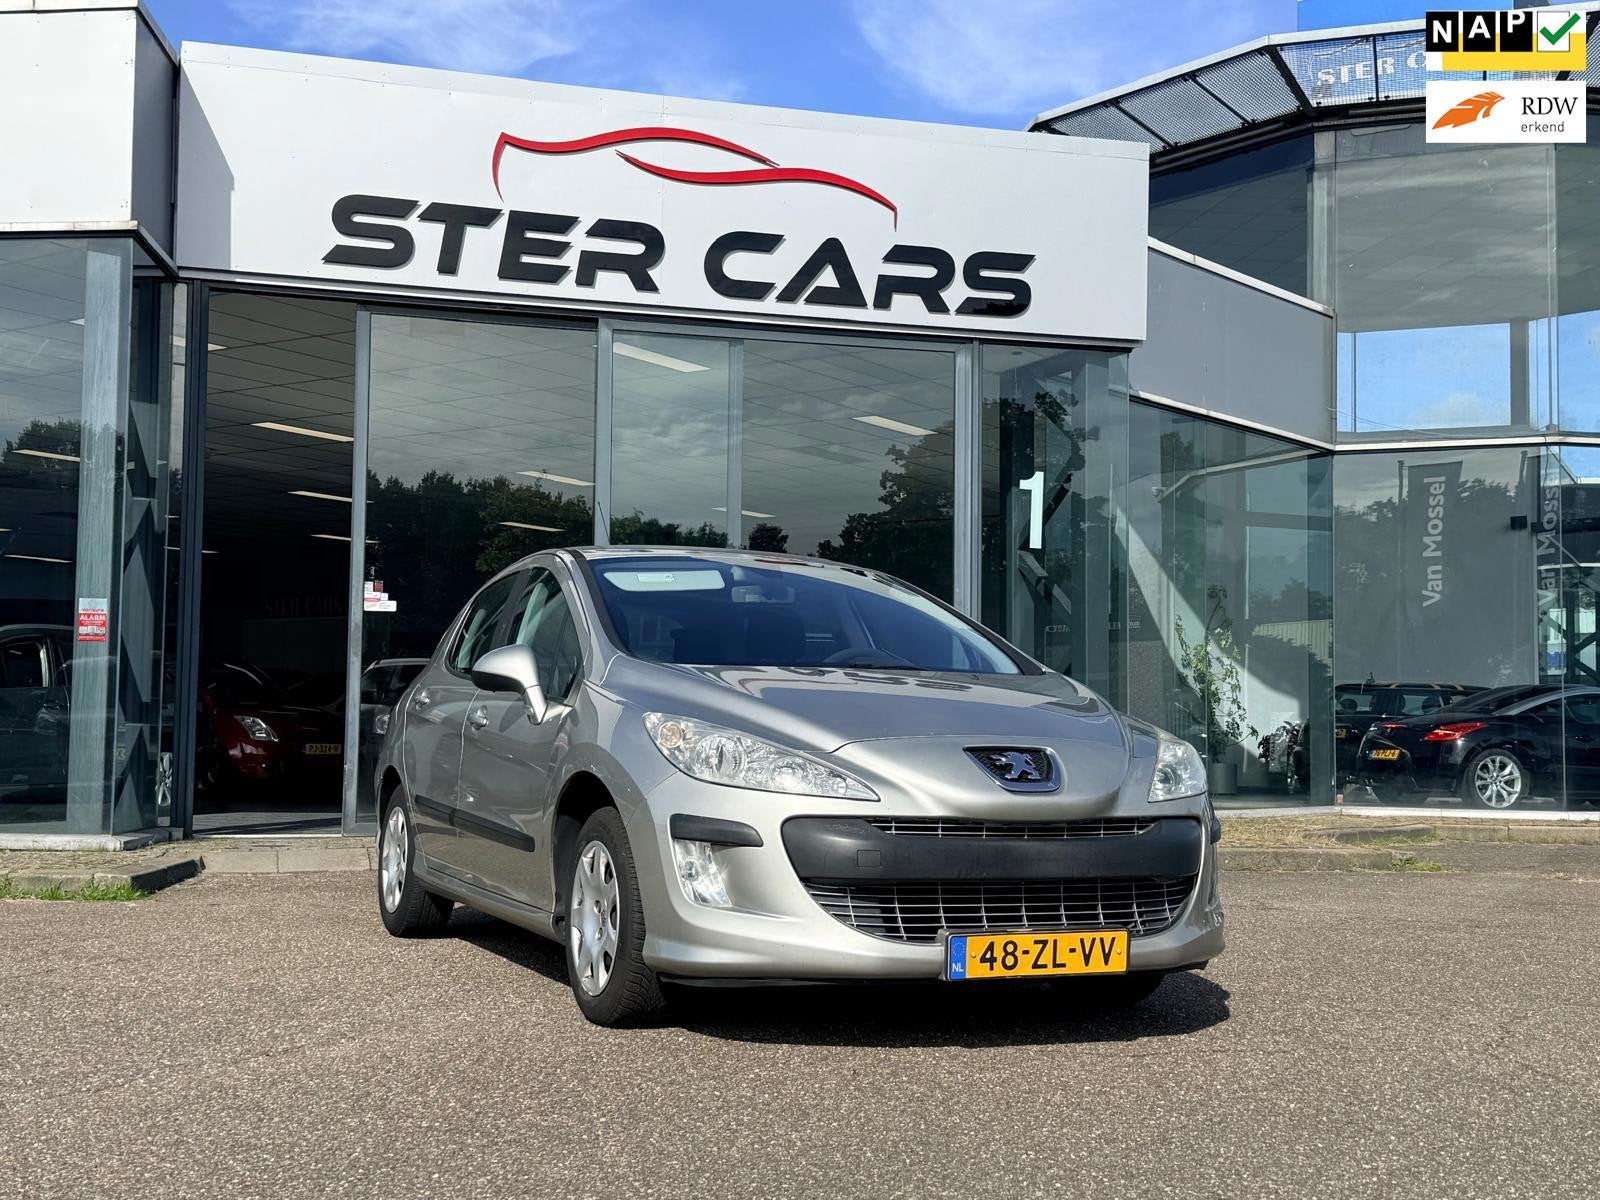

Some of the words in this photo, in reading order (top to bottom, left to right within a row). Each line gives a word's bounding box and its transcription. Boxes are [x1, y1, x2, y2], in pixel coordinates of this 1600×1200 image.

[1317, 57, 1395, 86] STER
[323, 194, 666, 295] STER
[703, 230, 1037, 318] CARS
[1019, 471, 1044, 549] 1
[1422, 476, 1446, 557] Mossel
[1422, 565, 1442, 607] Van
[952, 962, 965, 973] NL
[979, 937, 1116, 971] 48-ZL-VV
